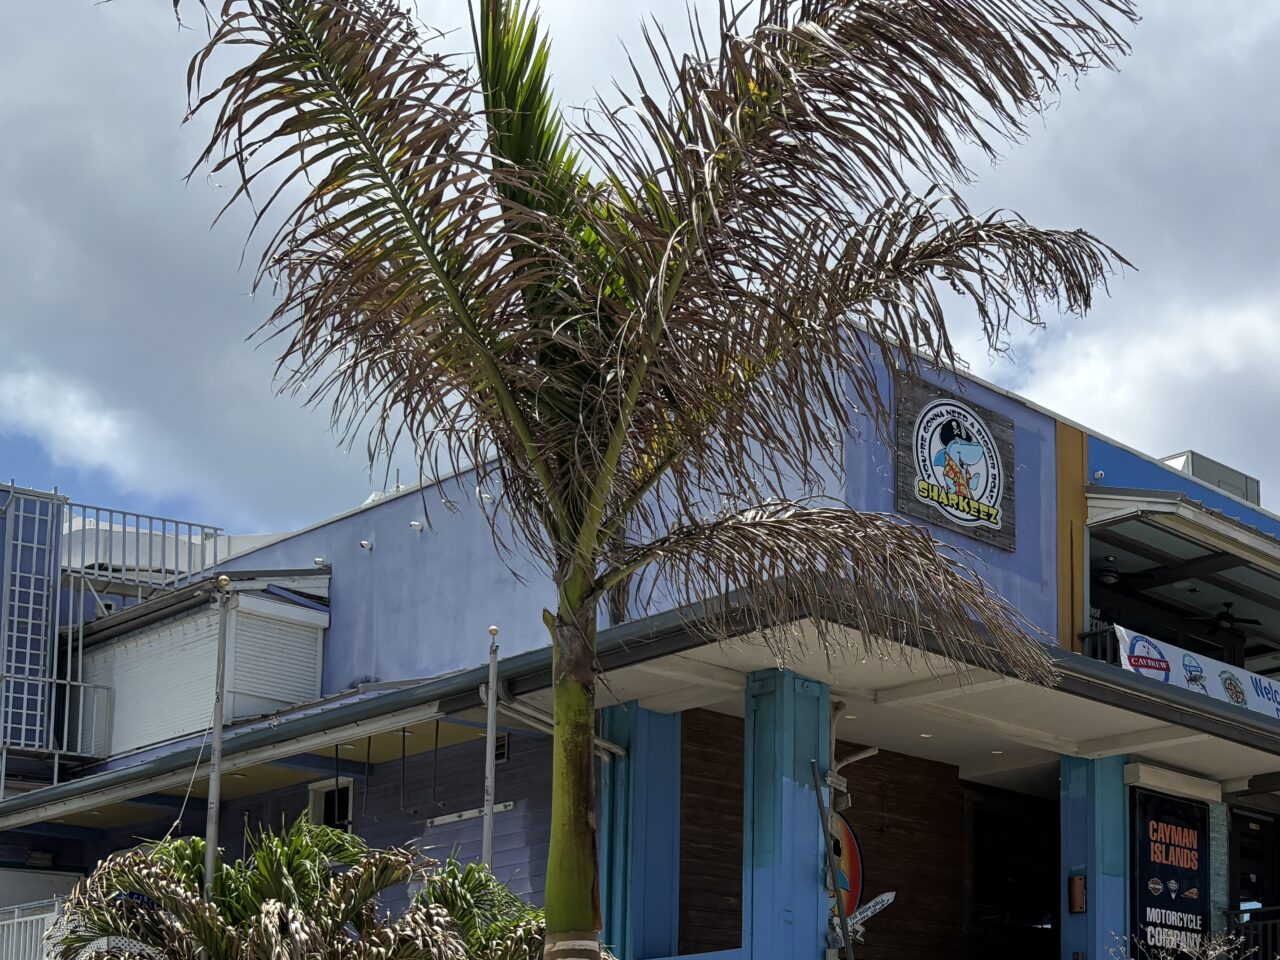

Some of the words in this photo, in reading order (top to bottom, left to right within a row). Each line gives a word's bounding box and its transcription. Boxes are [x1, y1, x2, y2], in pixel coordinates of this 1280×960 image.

[923, 409, 945, 434] GONNA
[945, 408, 969, 423] NEED
[976, 429, 996, 471] BIGGER
[917, 479, 1000, 525] SHARKEEZ
[1131, 657, 1168, 669] CAYBREW
[1148, 820, 1198, 849] CAYMAN
[1150, 842, 1199, 871] ISLANDS
[1146, 907, 1202, 930] MOTORCYCLE
